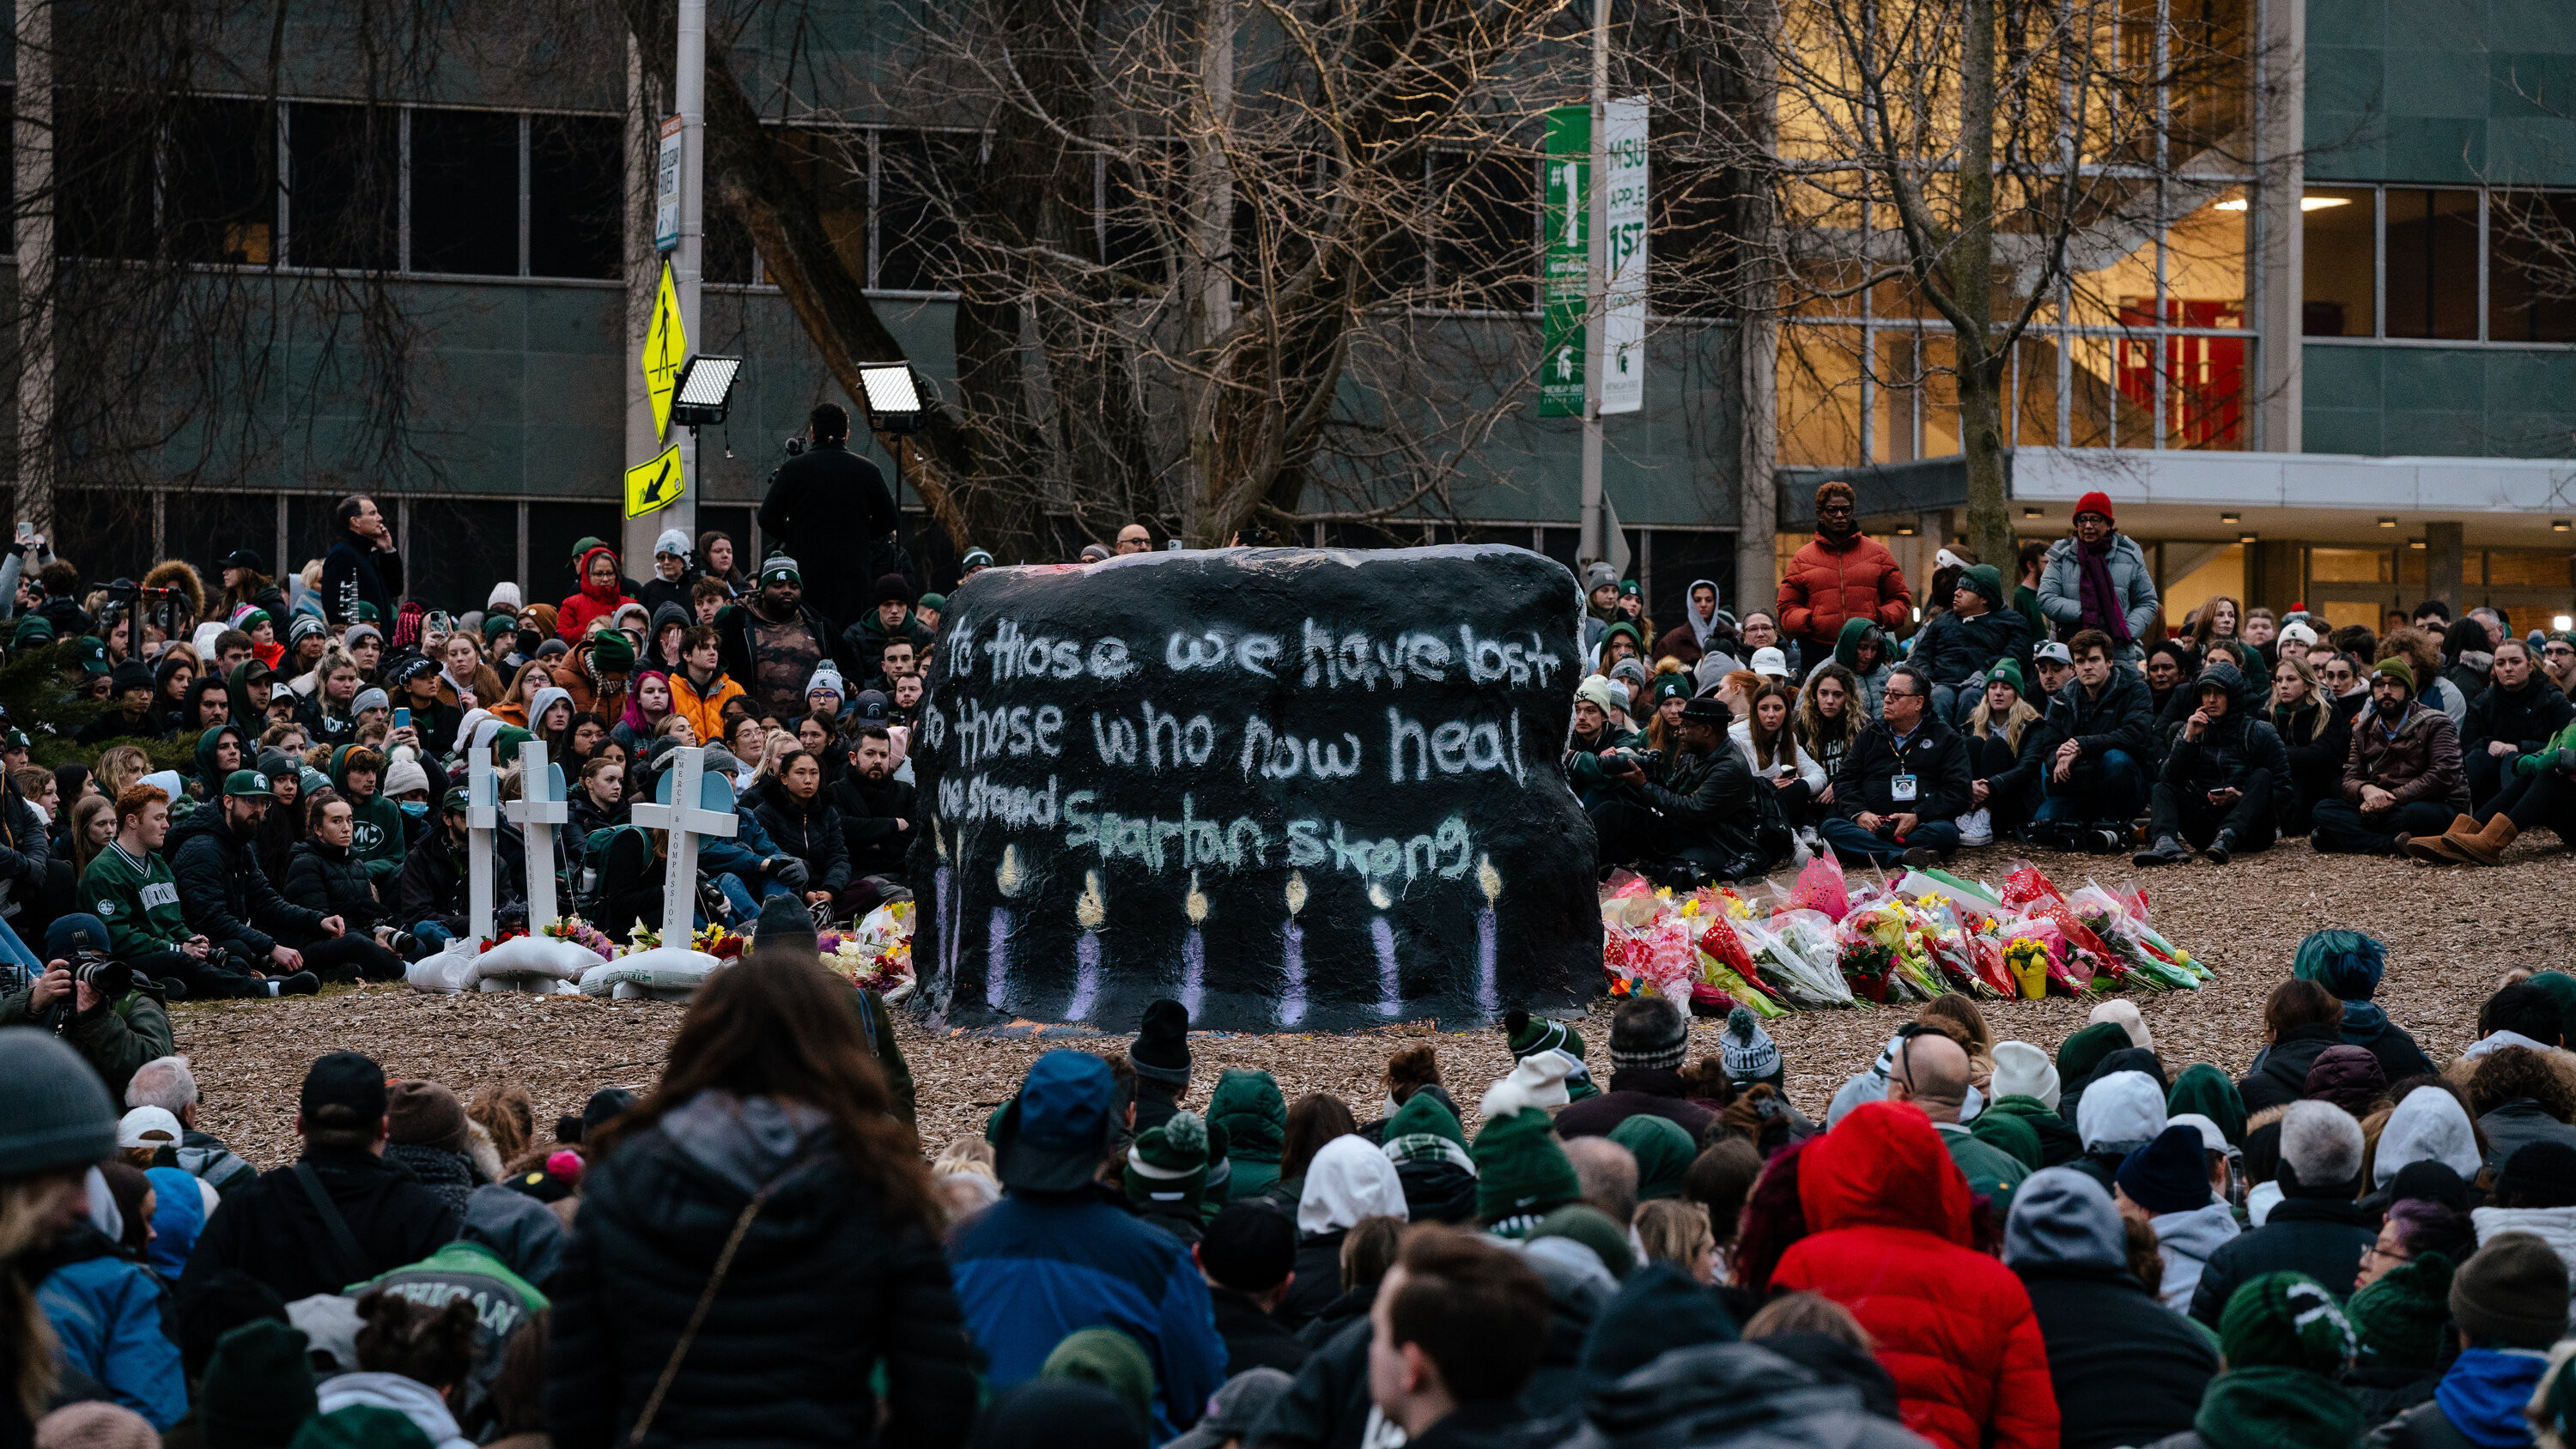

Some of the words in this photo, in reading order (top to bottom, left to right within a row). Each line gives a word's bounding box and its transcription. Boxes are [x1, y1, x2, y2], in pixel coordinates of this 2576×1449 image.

[1609, 137, 1646, 171] MSU
[1550, 162, 1578, 248] #1
[1610, 185, 1645, 209] APPLE
[1609, 221, 1643, 280] 1ST
[947, 615, 973, 678] to
[984, 616, 1140, 685] those
[1165, 628, 1285, 676] we
[1298, 617, 1450, 690] have
[1460, 624, 1560, 689] lost
[954, 694, 1063, 772] those
[1091, 700, 1214, 776] who
[1239, 712, 1361, 783] now
[1387, 706, 1526, 787] heal
[1063, 790, 1267, 876] Spartan
[667, 832, 679, 926] COMPASSION
